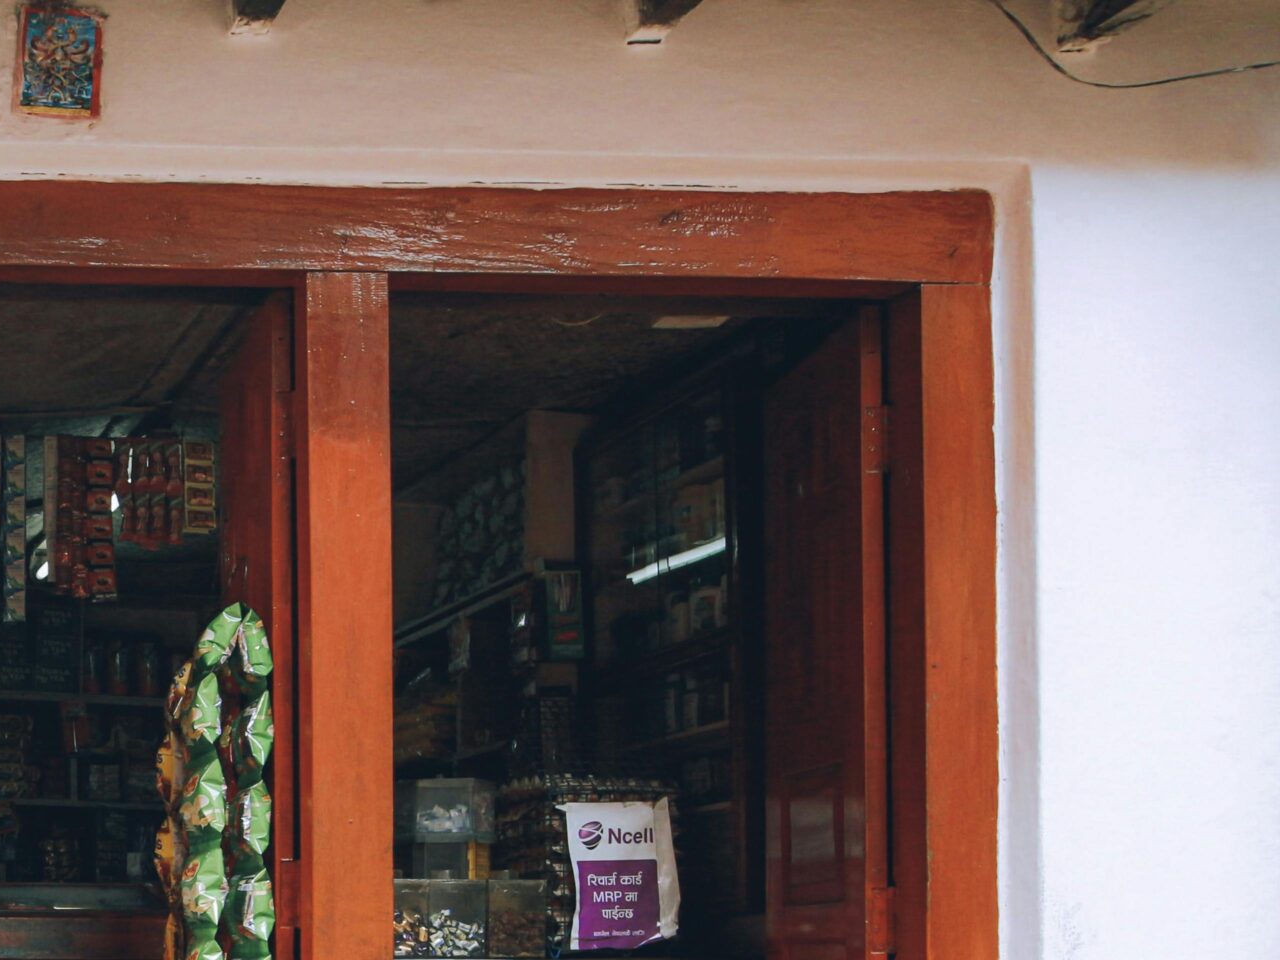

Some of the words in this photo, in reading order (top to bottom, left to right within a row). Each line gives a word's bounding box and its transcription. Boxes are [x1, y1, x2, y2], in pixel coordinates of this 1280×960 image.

[608, 828, 654, 844] Ncell
[619, 871, 643, 886] कार्ड
[593, 891, 622, 903] MRP
[624, 891, 638, 902] मा
[601, 905, 634, 920] पाईन्छ
